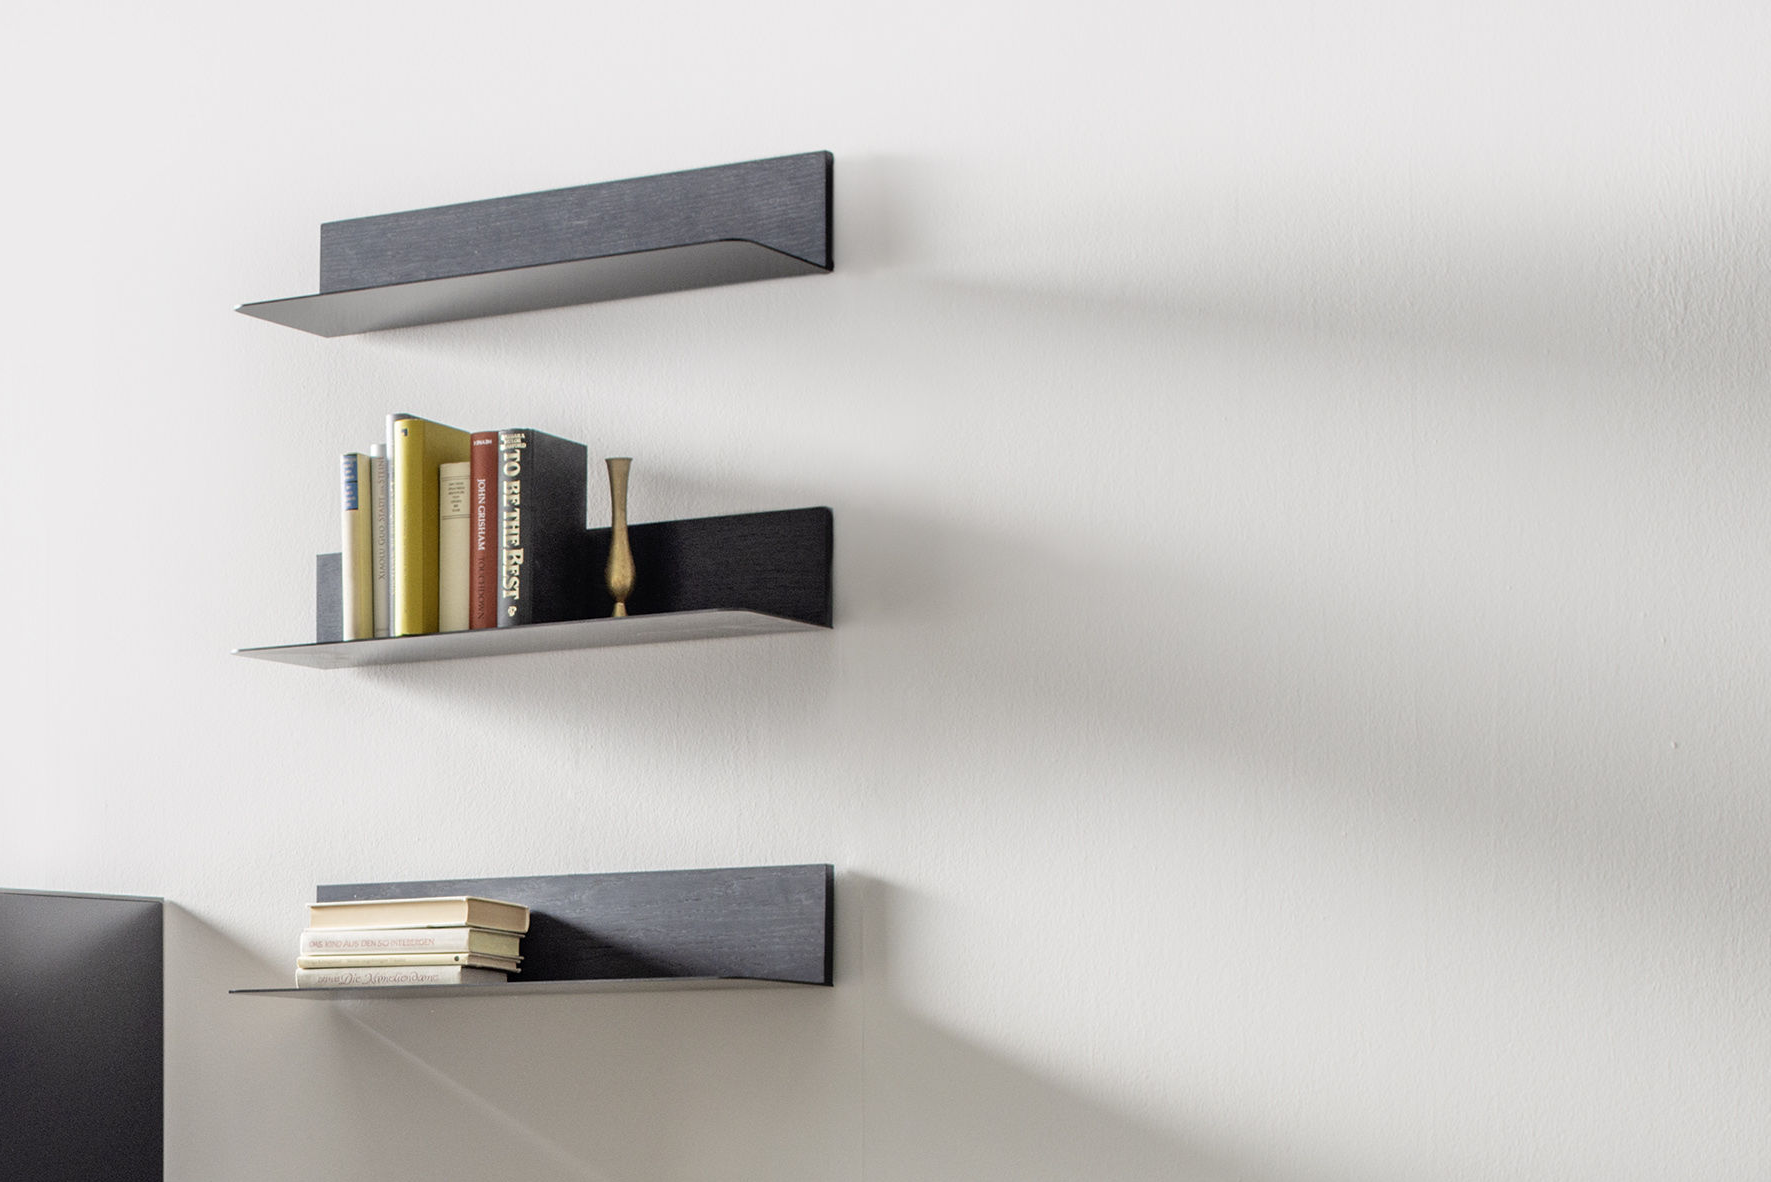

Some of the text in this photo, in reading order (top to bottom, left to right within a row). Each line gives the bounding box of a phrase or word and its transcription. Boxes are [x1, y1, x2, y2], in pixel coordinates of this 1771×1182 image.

[477, 478, 486, 504] JOHN
[477, 505, 486, 551] GRISHAM
[503, 449, 524, 600] TO BE THE BEST
[309, 938, 435, 948] DAS KIND AUS DEN SCHNEEBERGEN
[339, 972, 362, 985] Die
